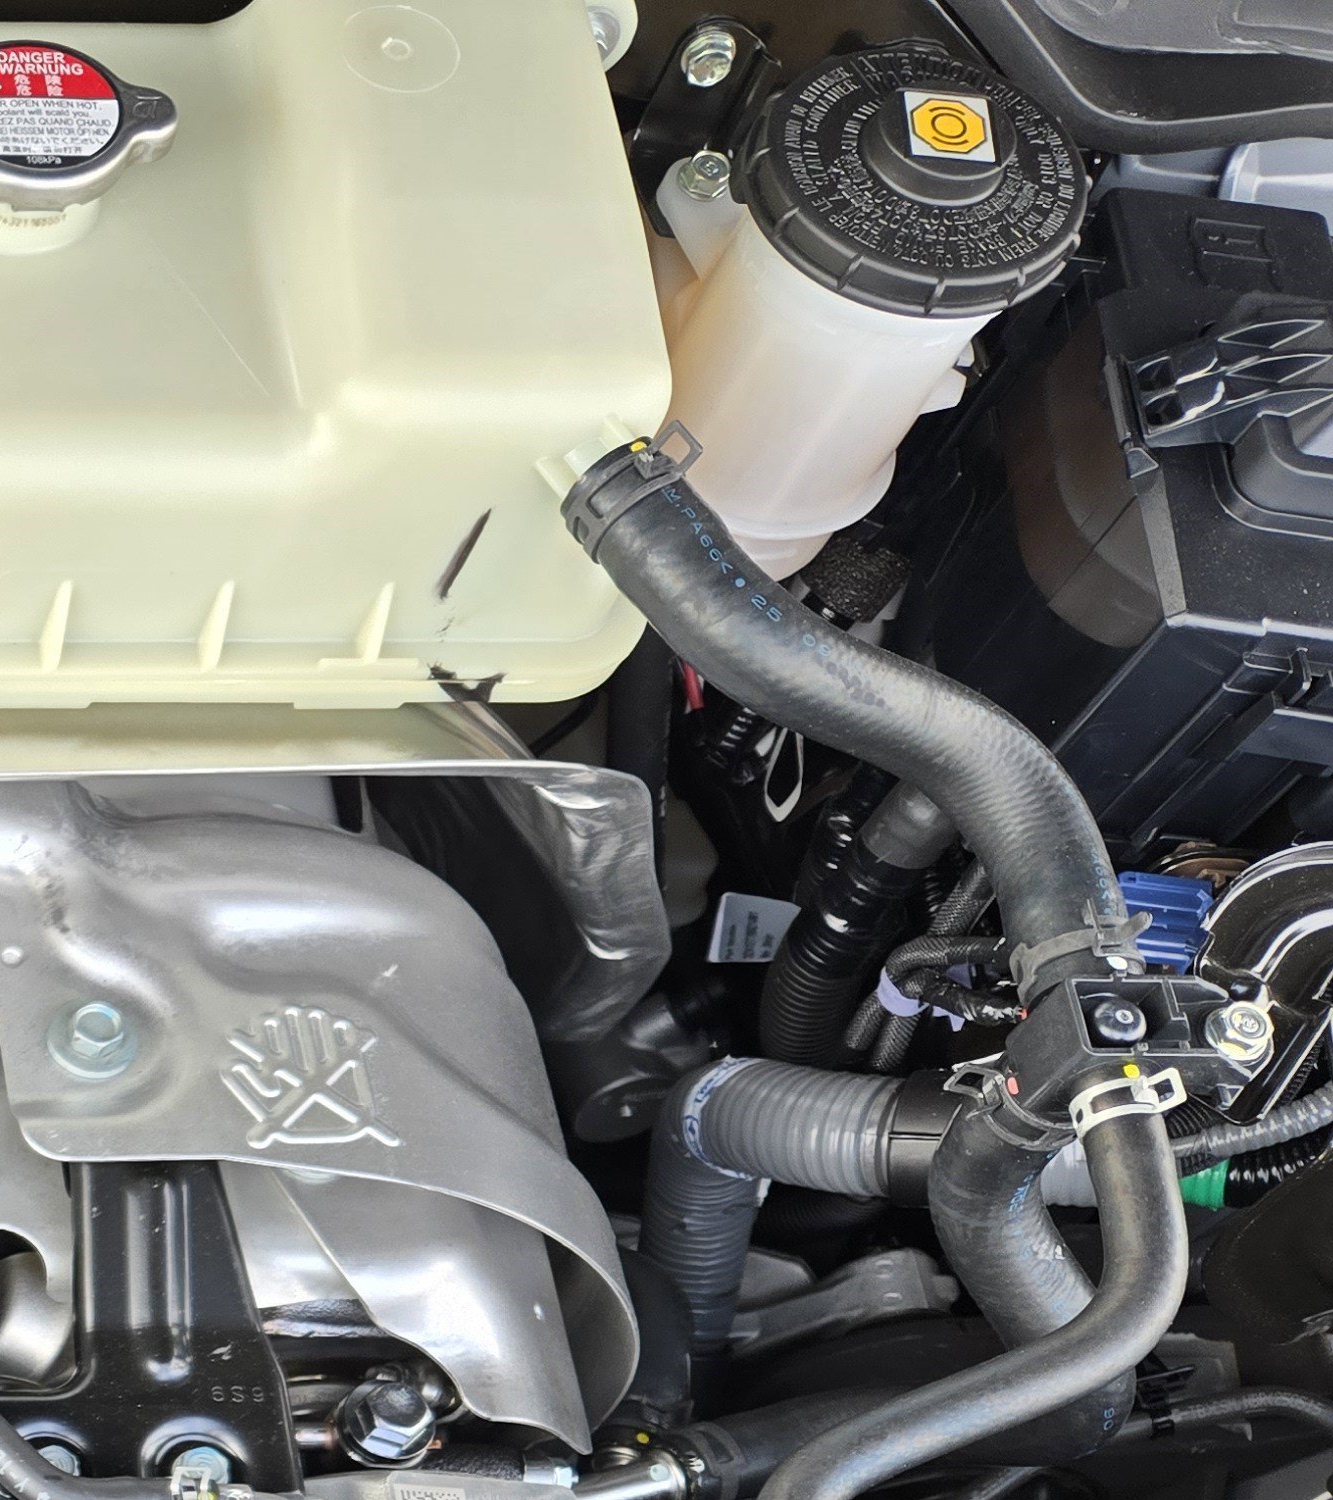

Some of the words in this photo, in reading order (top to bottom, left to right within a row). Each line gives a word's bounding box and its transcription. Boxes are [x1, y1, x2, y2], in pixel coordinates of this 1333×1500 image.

[42, 101, 74, 109] WHEN
[812, 197, 833, 213] LE
[998, 236, 1039, 262] FREIN
[751, 594, 783, 622] 25
